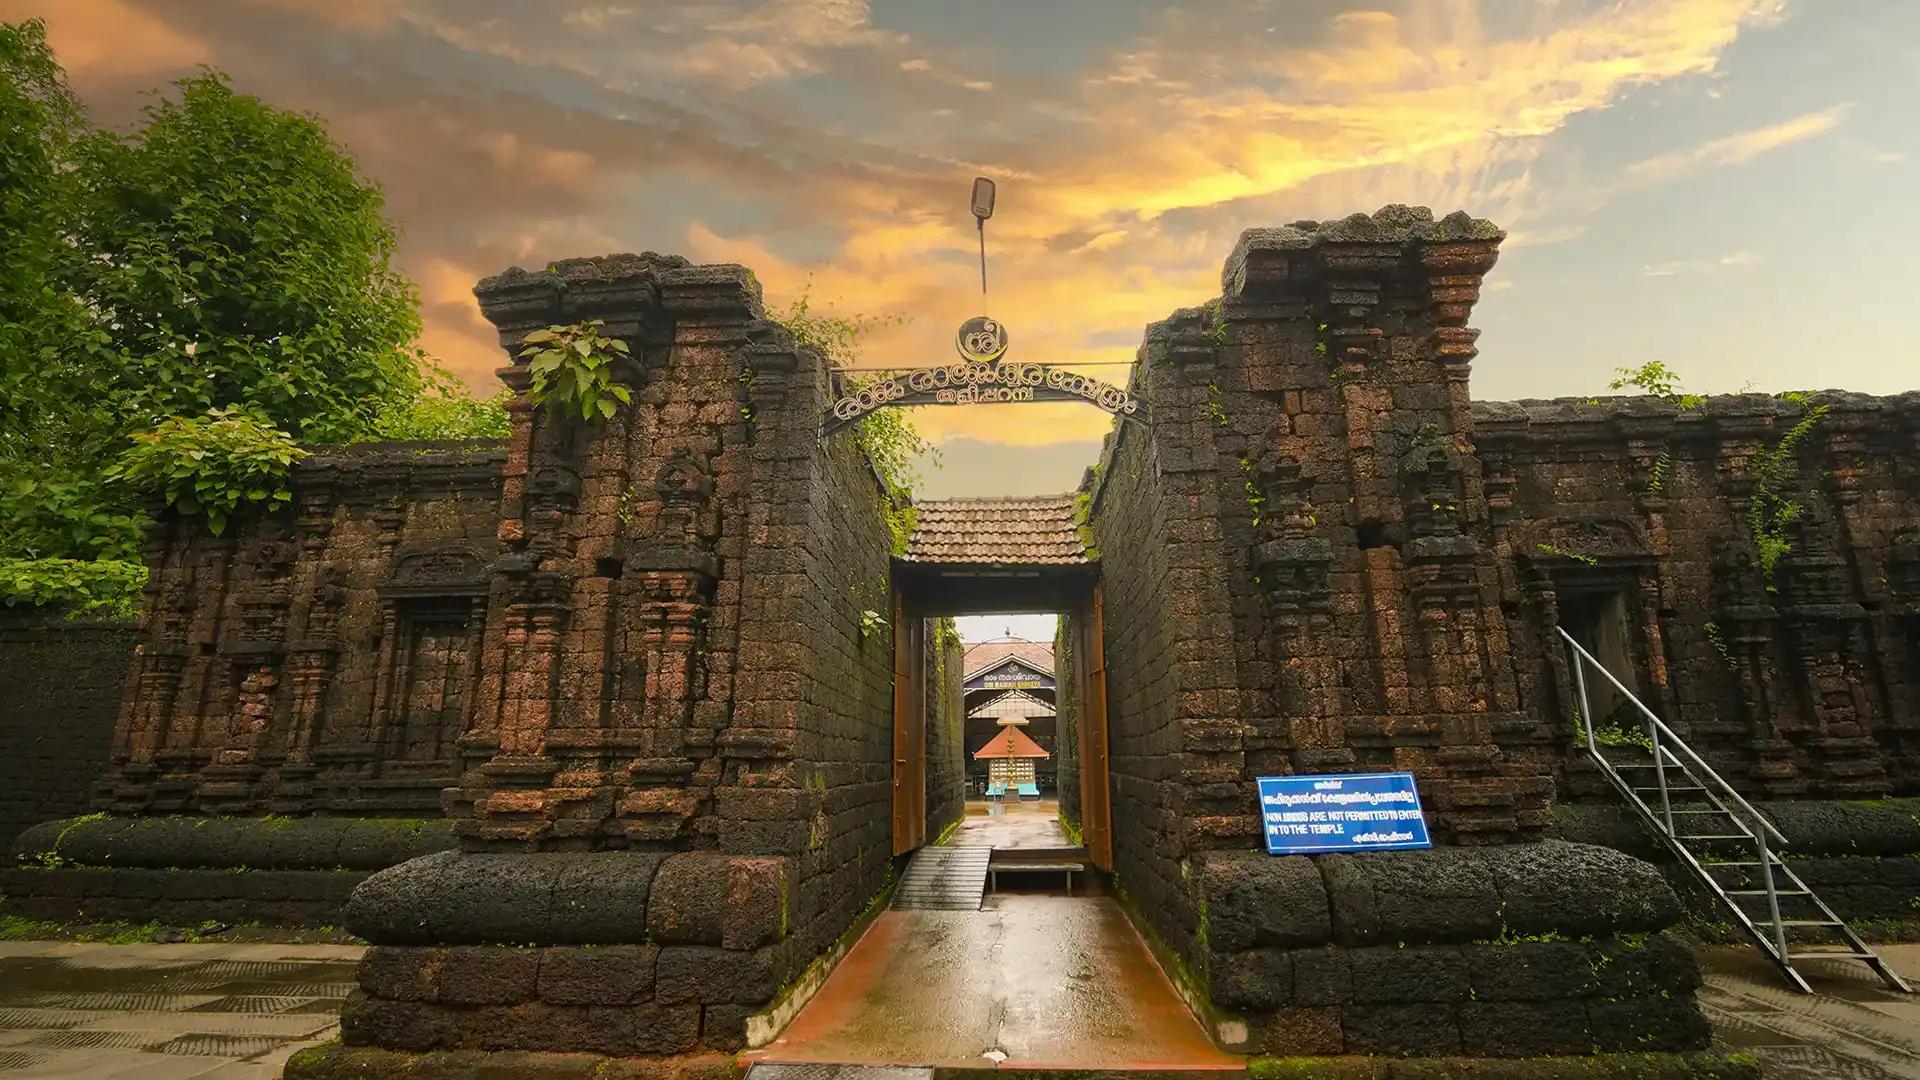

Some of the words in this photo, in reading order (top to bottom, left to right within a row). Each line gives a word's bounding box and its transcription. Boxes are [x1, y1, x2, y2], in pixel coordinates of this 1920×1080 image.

[1266, 812, 1282, 822] NON
[1309, 811, 1327, 822] ARE
[1327, 811, 1344, 821] NOT
[1344, 810, 1388, 821] PERMITTED
[1288, 824, 1309, 835] THE
[1308, 823, 1345, 835] TEMPLE
